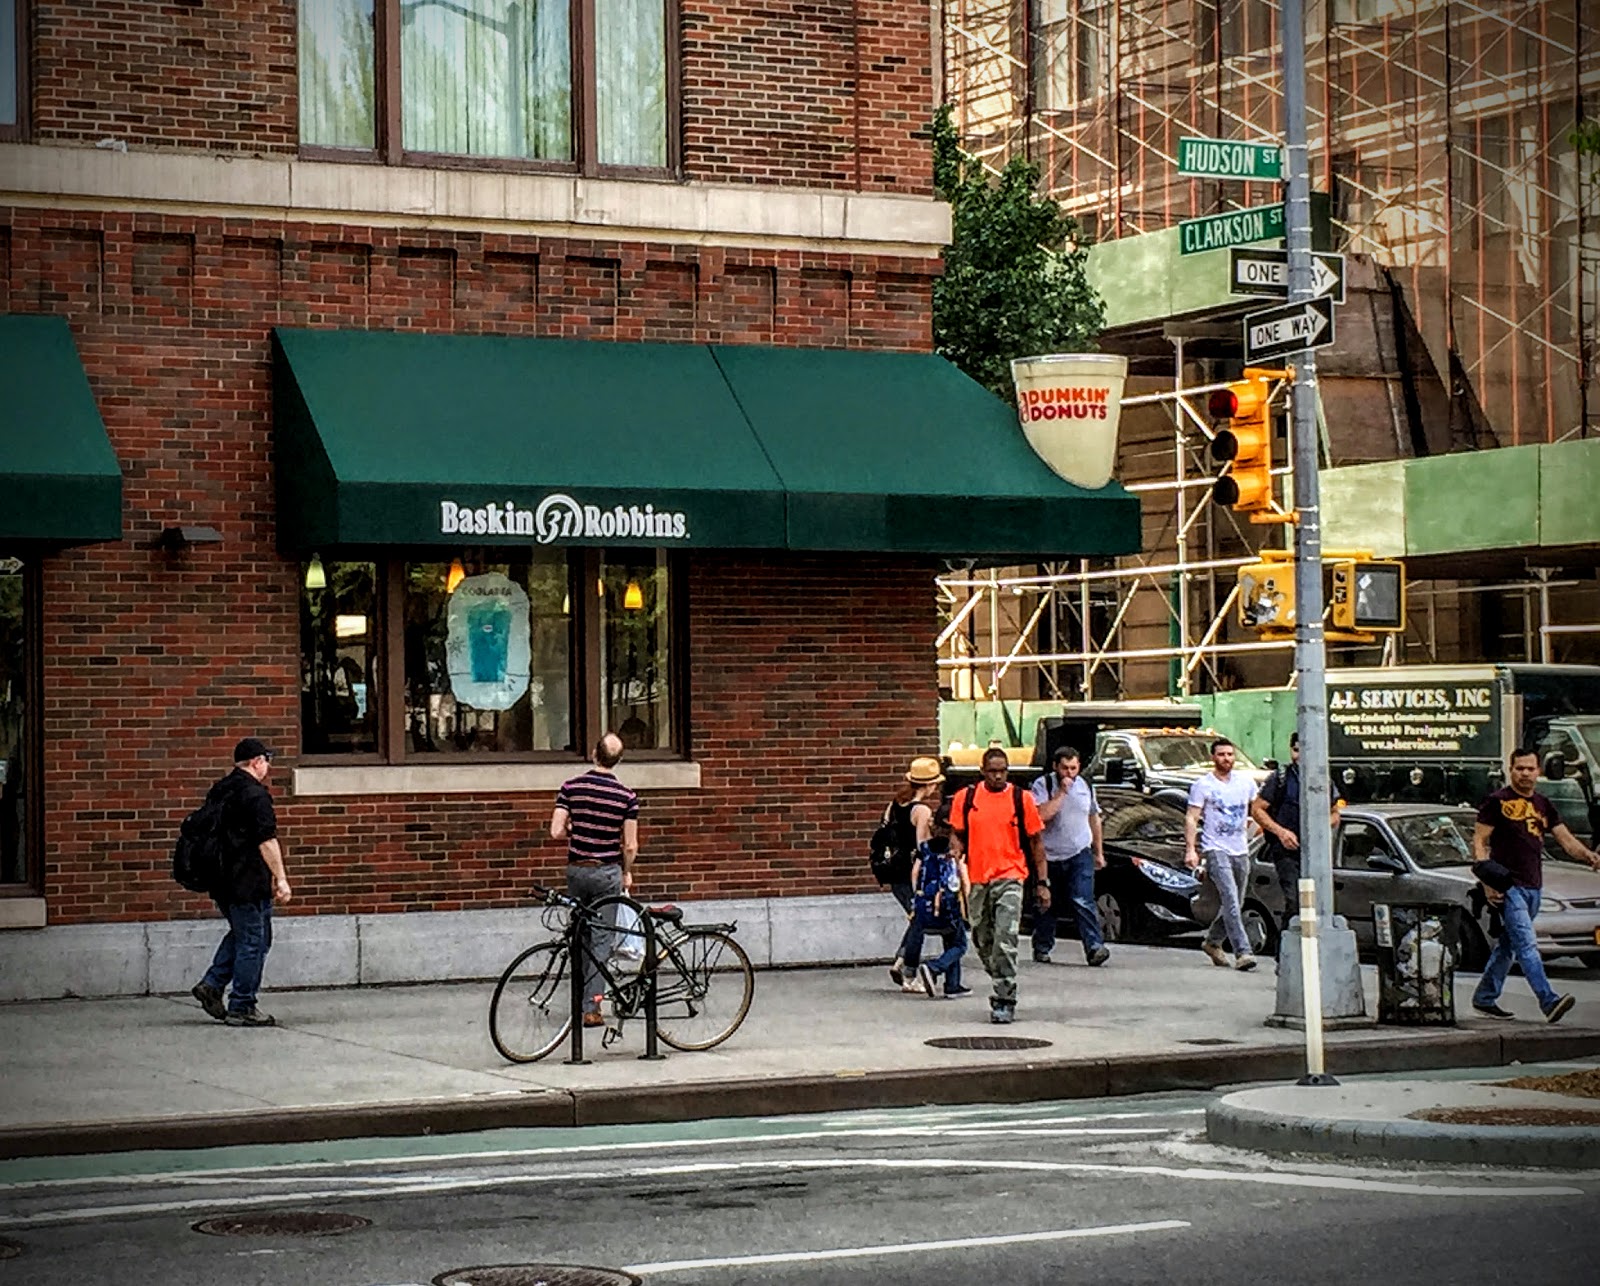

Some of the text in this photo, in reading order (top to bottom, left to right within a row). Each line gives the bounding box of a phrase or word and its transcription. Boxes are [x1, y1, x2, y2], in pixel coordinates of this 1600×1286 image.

[1185, 142, 1278, 175] HUDSON ST
[1186, 208, 1283, 252] CLARKSON ST
[1247, 263, 1280, 283] ONE
[1257, 315, 1318, 345] ONE WAY
[1028, 387, 1110, 405] DUNKIN'
[1031, 404, 1107, 421] DONUTS
[440, 501, 534, 535] Baskin
[537, 506, 577, 544] 31
[1329, 688, 1491, 711] A-L SERVICES, INC
